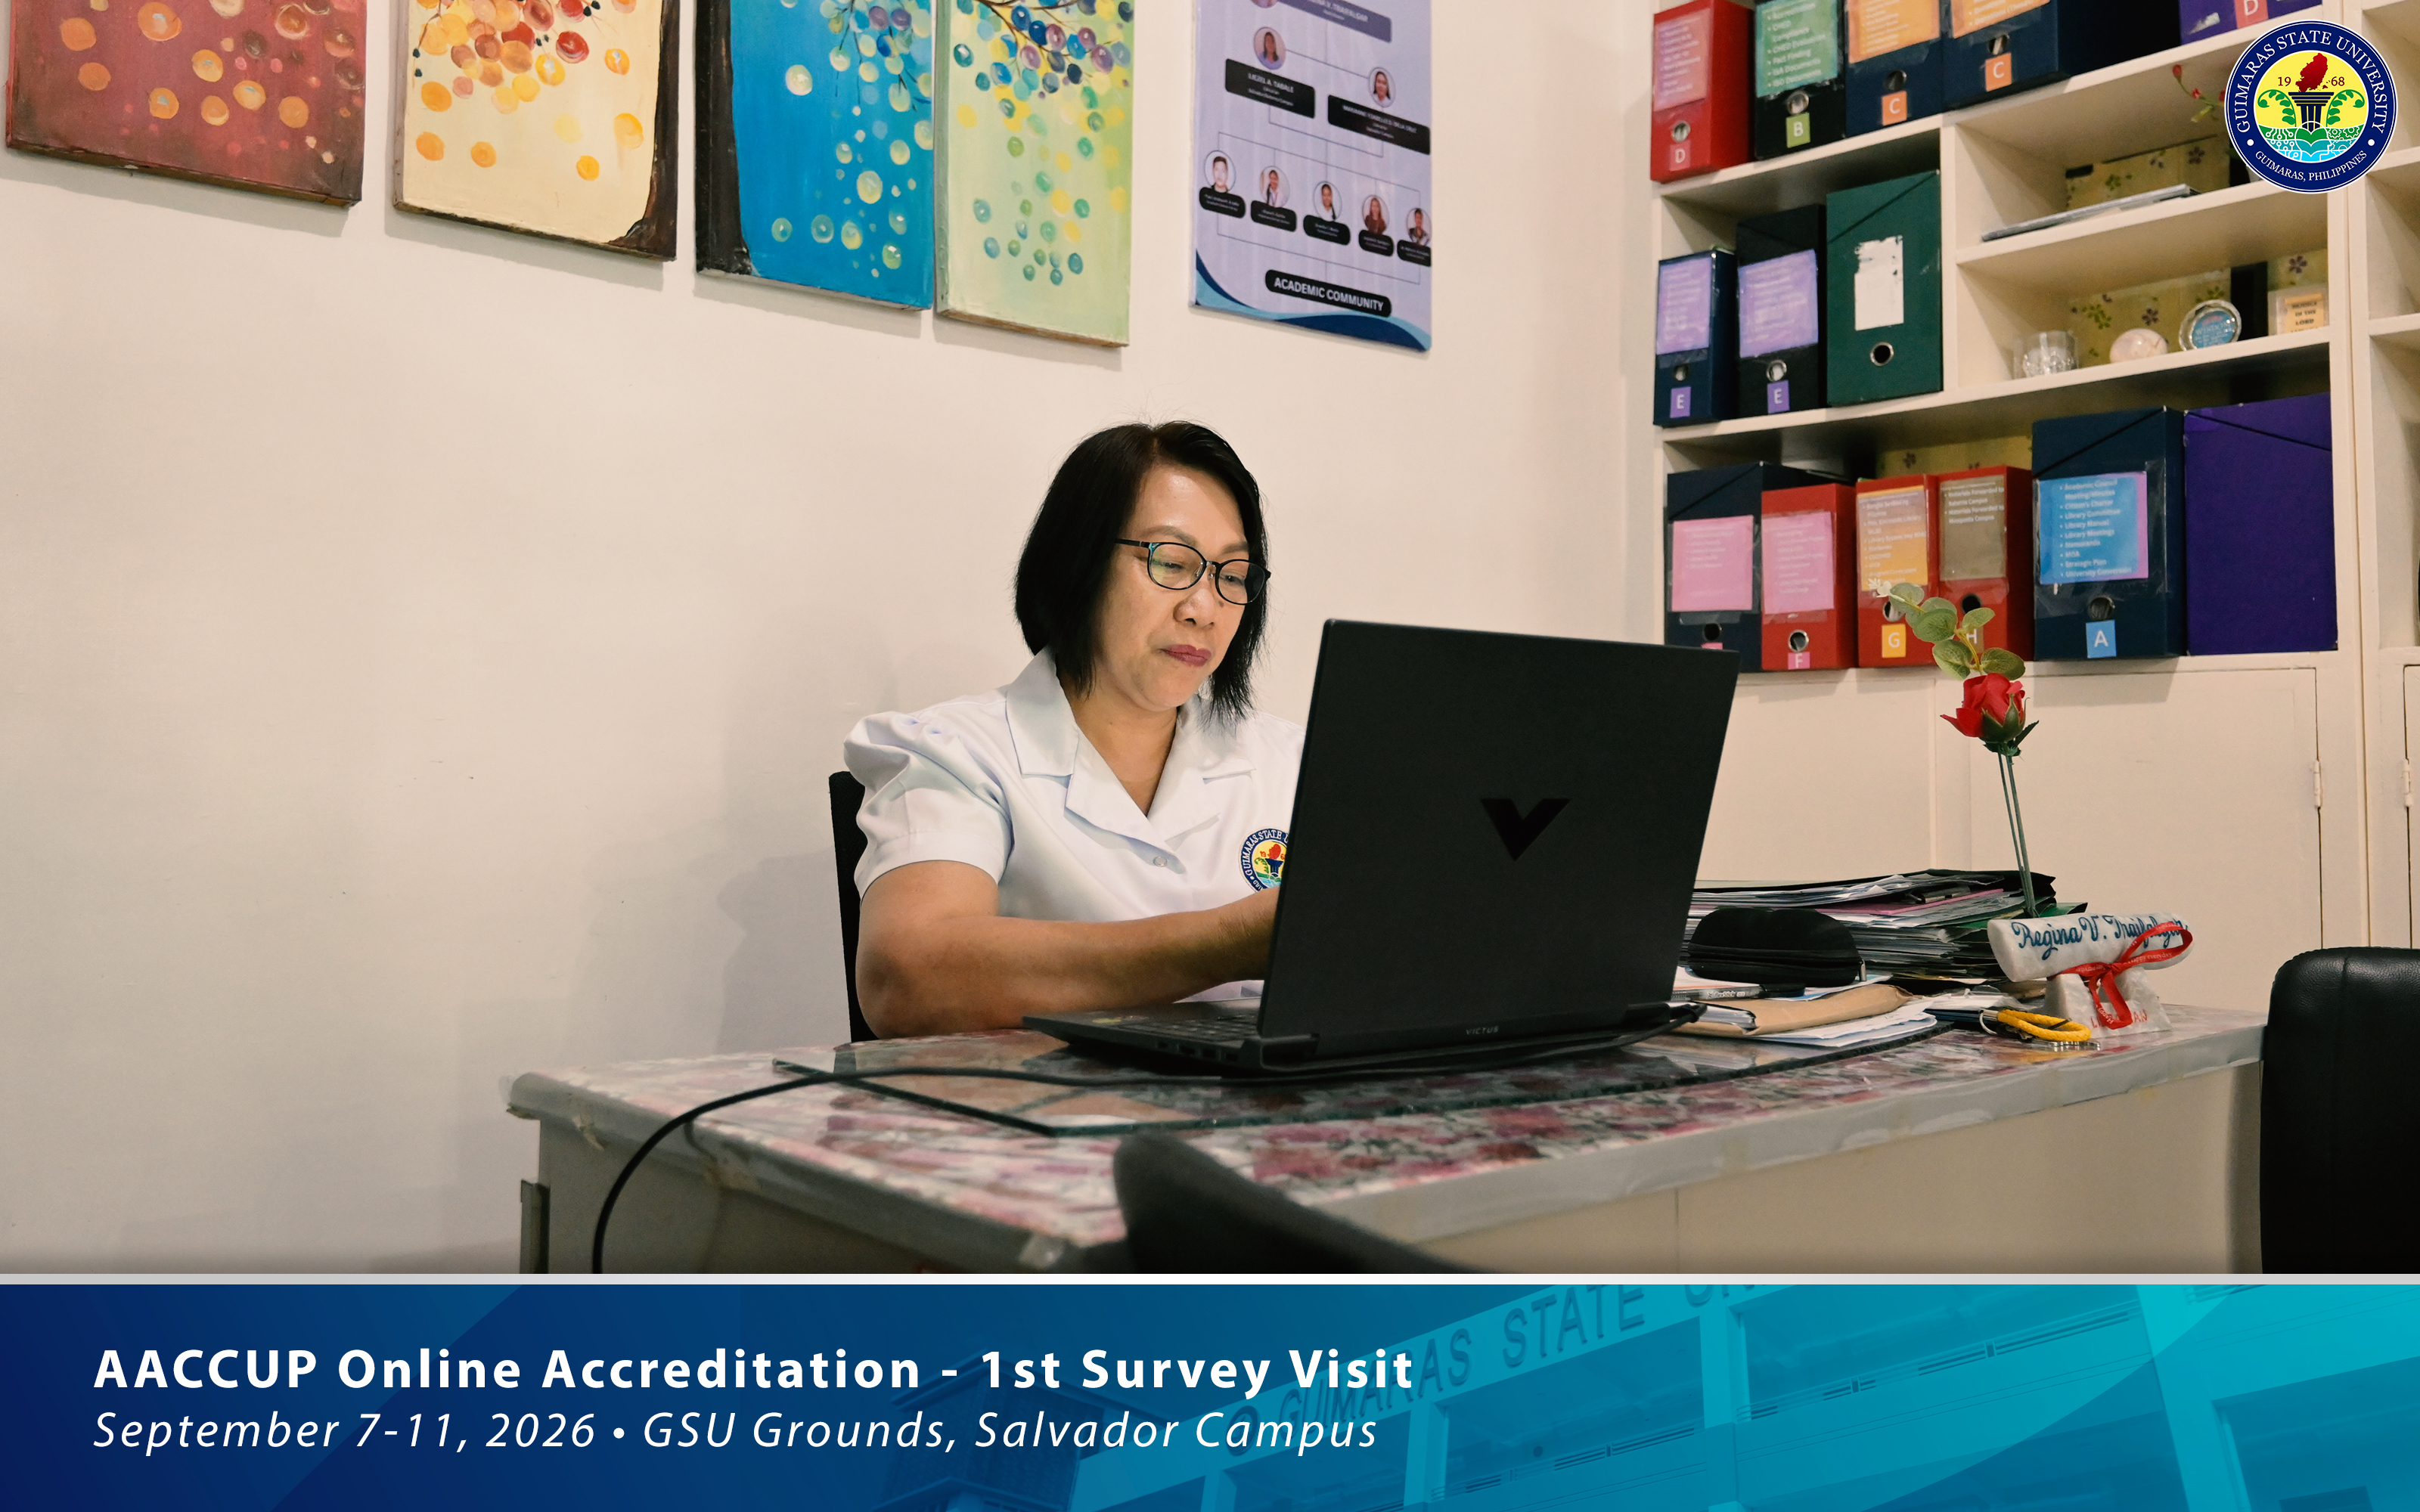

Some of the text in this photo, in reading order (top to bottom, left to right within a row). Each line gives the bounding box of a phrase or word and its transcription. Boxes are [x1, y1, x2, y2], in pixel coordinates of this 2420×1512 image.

[1993, 62, 2004, 79] C
[1889, 98, 1900, 114] C
[1793, 121, 1804, 137] B
[1674, 148, 1686, 164] D
[1274, 277, 1384, 311] ACADEMIC COMMUNITY
[1676, 394, 1684, 409] E
[1773, 389, 1782, 404] E
[1888, 632, 1900, 648] G
[1966, 628, 1978, 644] H
[2094, 630, 2108, 647] A
[1795, 652, 1804, 668] F
[1243, 835, 1258, 876] GUIMARAS
[1258, 830, 1283, 841] STATE
[2011, 922, 2082, 961] Regina
[2078, 915, 2107, 942] V.
[1466, 1026, 1499, 1035] VICTUS
